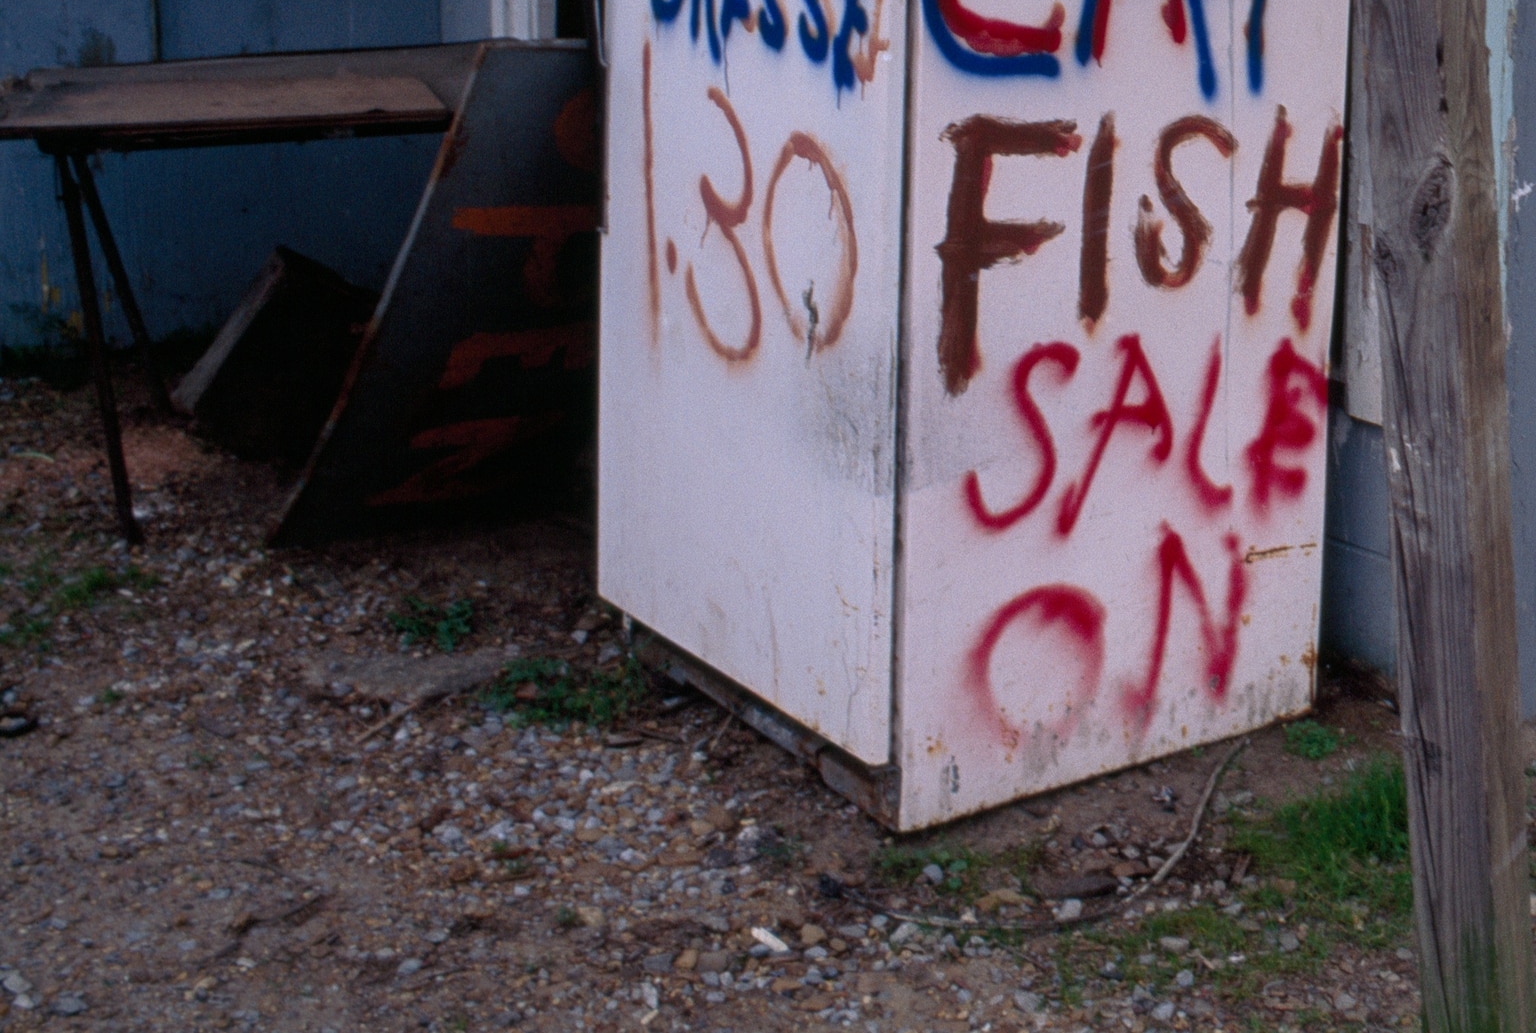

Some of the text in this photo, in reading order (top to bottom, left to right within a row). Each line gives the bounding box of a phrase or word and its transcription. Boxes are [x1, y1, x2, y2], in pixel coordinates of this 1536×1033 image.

[936, 104, 1345, 396] FISH
[963, 334, 1330, 540] SALE
[963, 521, 1250, 748] ON
